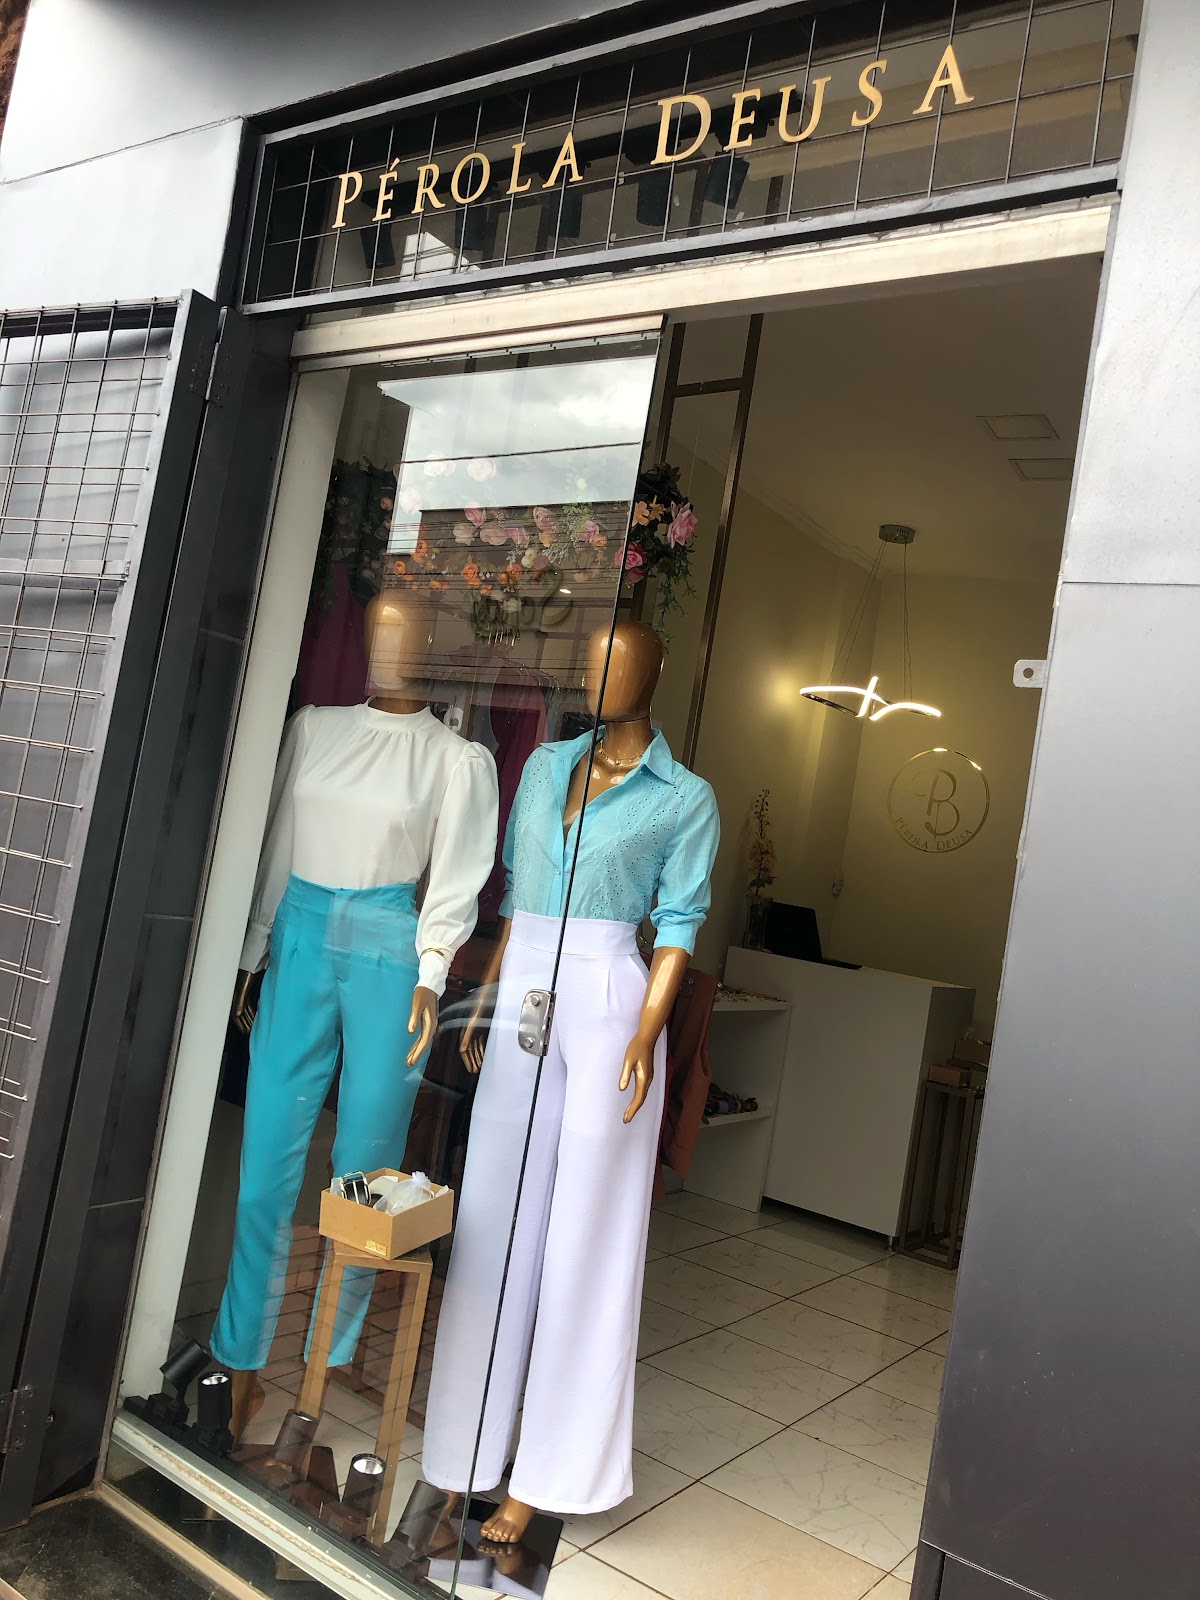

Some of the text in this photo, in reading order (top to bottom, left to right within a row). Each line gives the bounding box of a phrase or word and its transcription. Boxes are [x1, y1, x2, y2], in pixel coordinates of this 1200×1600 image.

[331, 44, 975, 229] PÉROLA DEUSA
[936, 829, 973, 851] DEUSA
